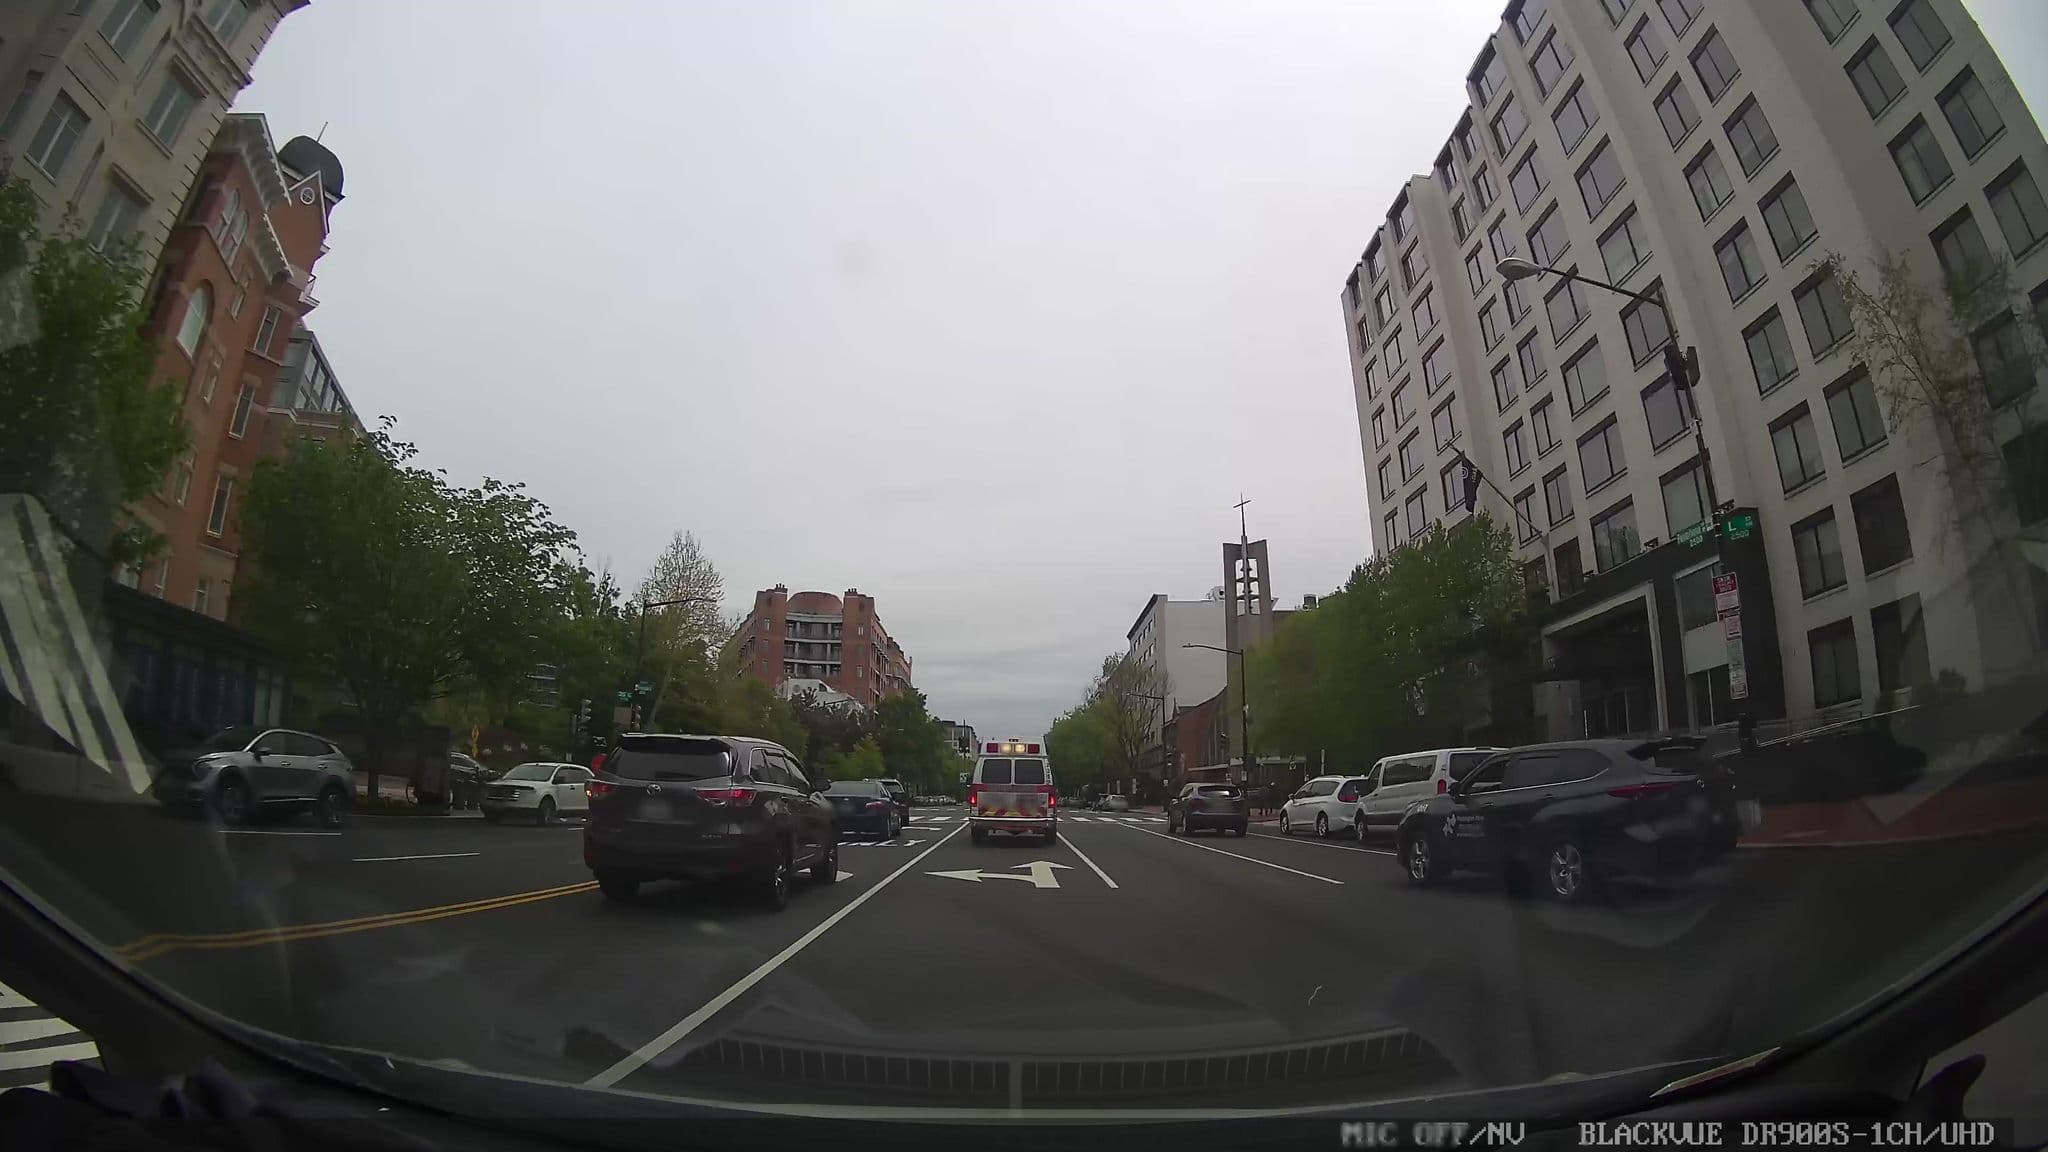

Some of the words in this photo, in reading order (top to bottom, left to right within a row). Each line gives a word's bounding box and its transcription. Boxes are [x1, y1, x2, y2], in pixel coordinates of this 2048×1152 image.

[1728, 521, 1737, 531] L
[1730, 529, 1750, 540] 2500
[1689, 534, 1703, 547] 2500
